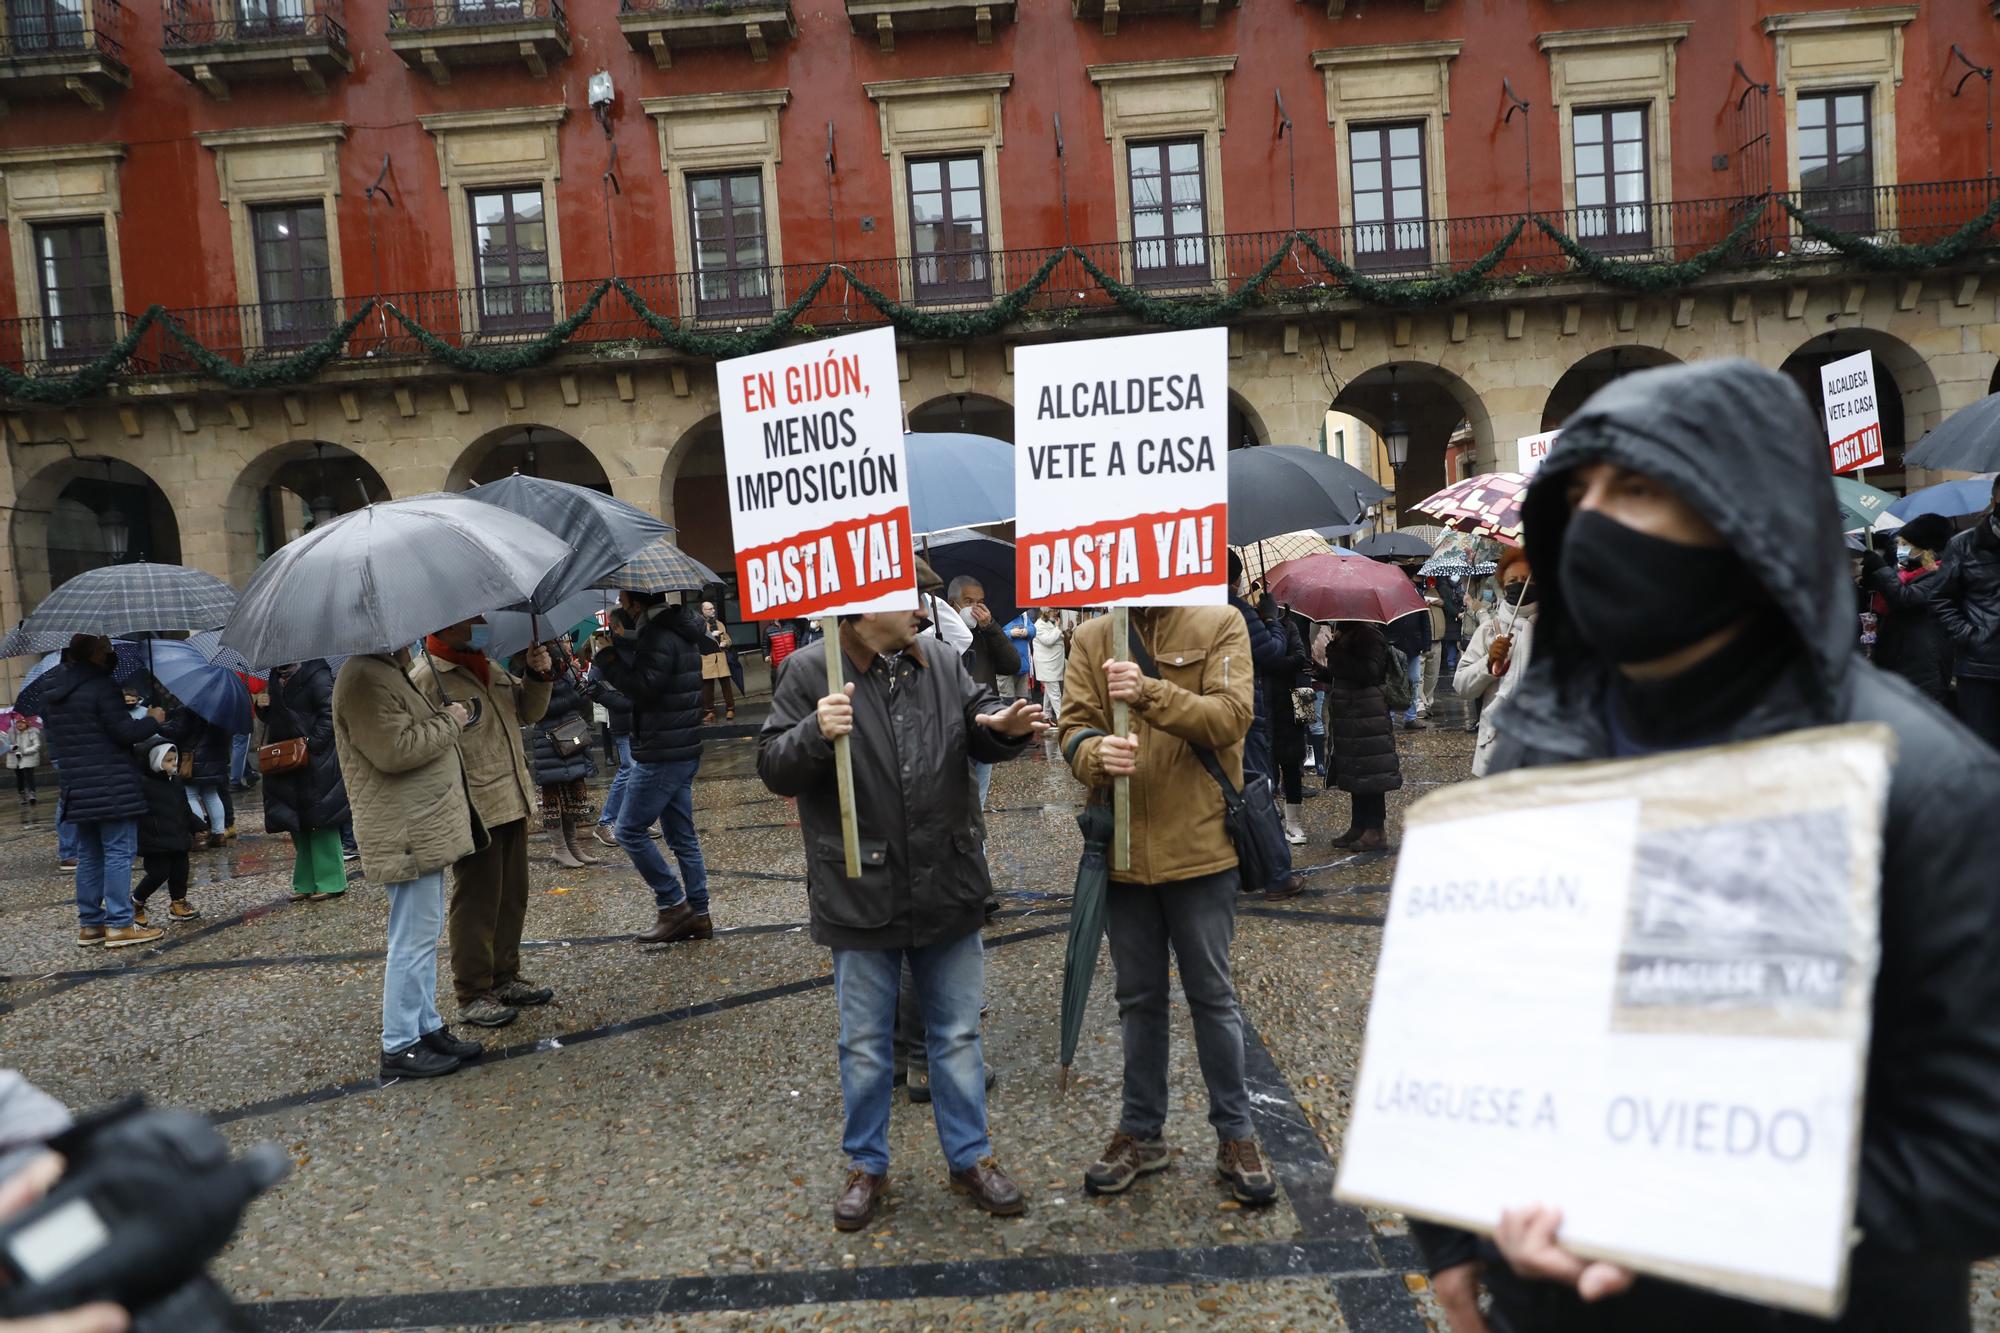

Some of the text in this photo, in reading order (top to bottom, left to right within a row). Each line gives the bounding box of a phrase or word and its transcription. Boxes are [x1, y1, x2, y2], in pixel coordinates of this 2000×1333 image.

[742, 349, 870, 413] EN GIJÓN,
[1037, 373, 1204, 420] ALCALDESA
[1828, 370, 1869, 396] ALCALDESA
[763, 408, 857, 459] MENOS
[1828, 395, 1875, 421] VETE A CASA
[1027, 436, 1215, 480] VETE A CASA
[1530, 440, 1547, 457] EN
[1833, 427, 1879, 470] BASTA YA!
[736, 447, 898, 512] IMPOSICIÓN
[746, 520, 901, 614] BASTA YA!
[1029, 515, 1214, 600] BASTA YA!
[1404, 862, 1590, 919] BARRAGÁN,
[1373, 1070, 1814, 1165] LÁRGUESE A OVIEDO
